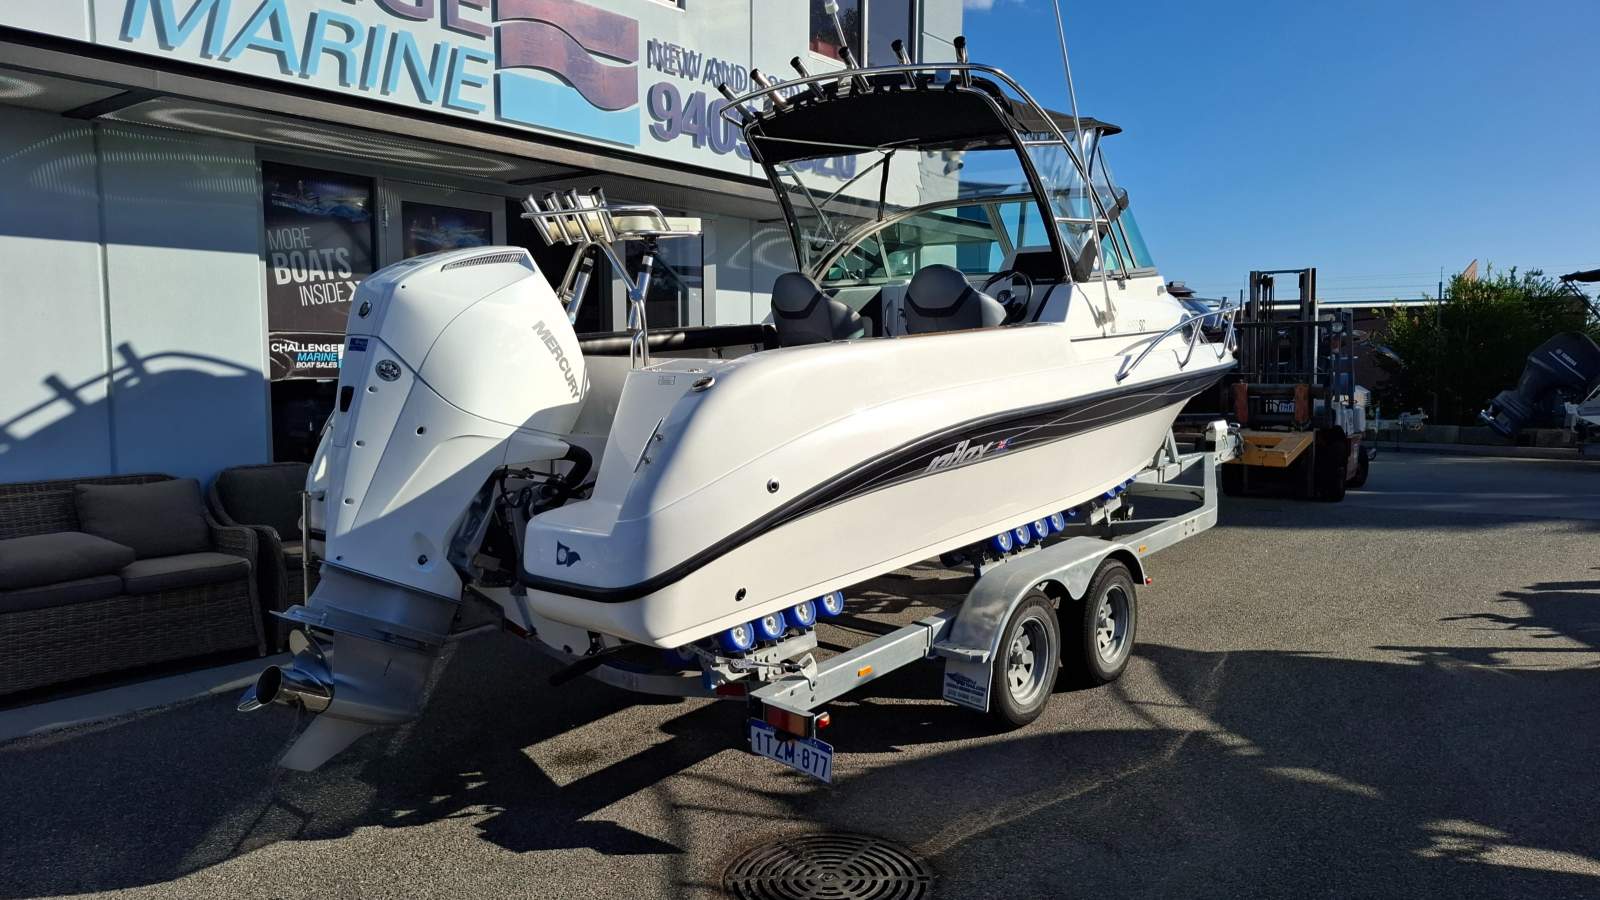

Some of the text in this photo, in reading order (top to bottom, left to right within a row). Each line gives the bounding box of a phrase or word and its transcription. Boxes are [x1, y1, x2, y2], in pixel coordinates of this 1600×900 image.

[121, 0, 495, 114] MARINE
[647, 38, 702, 81] NEW
[702, 57, 748, 94] AND
[267, 227, 312, 251] MORE
[272, 247, 353, 286] BOATS
[299, 282, 347, 307] INSIDE
[271, 343, 338, 353] CHALLENGE
[297, 352, 337, 361] MARINE
[531, 320, 580, 399] MERCURY
[296, 361, 338, 369] BOAT SALES
